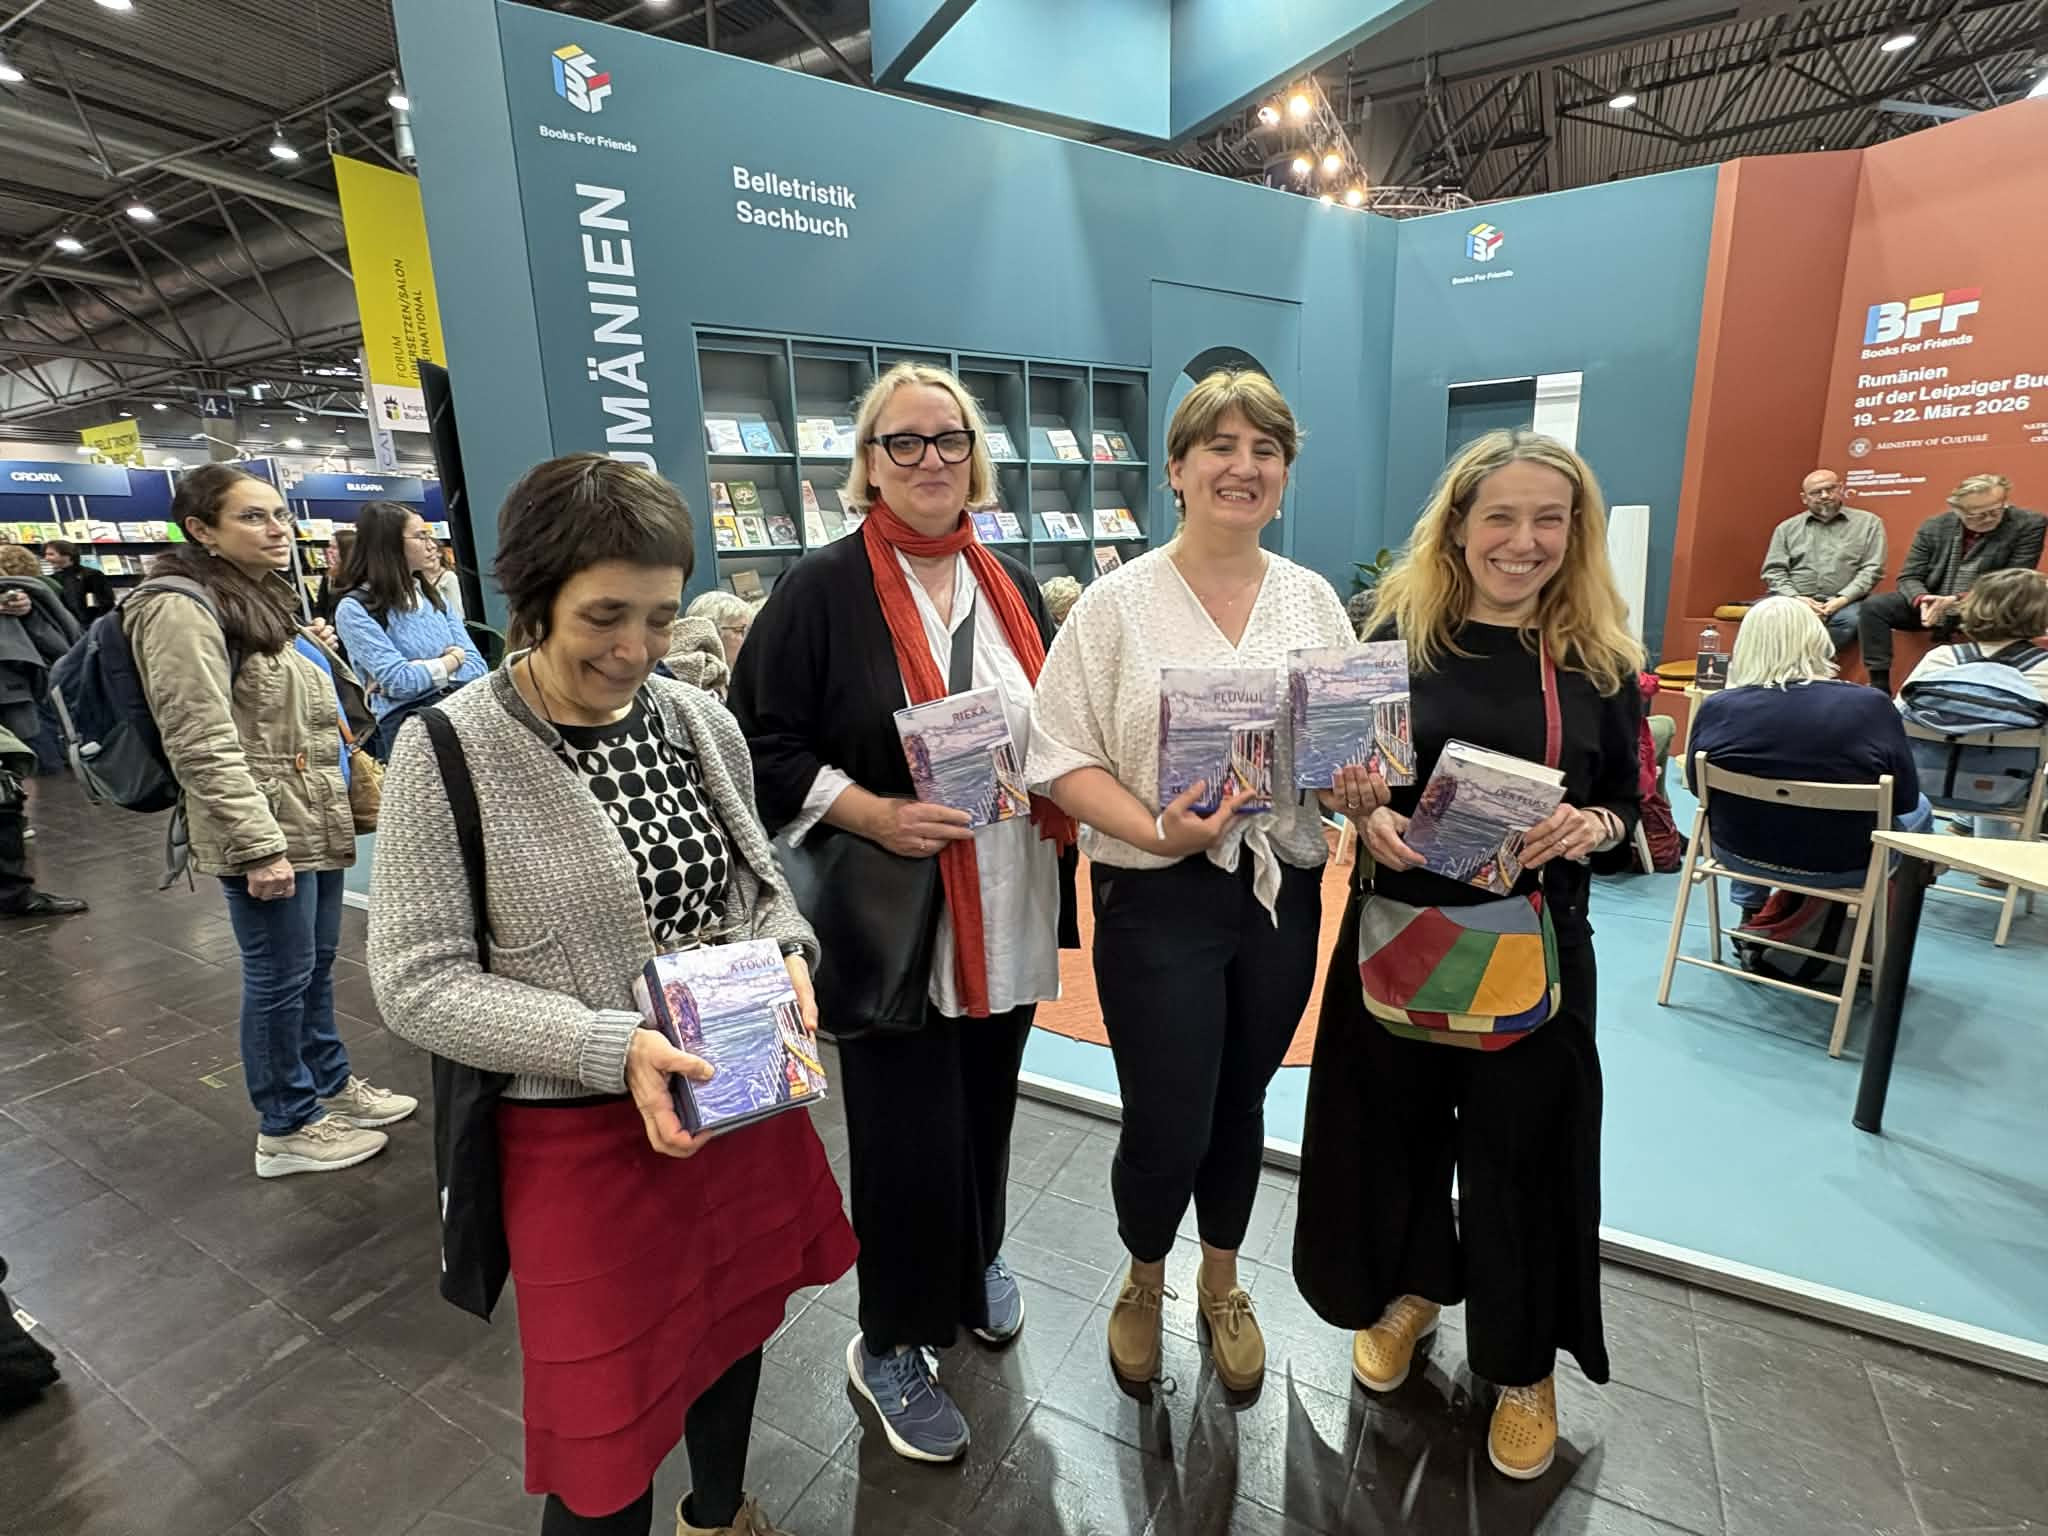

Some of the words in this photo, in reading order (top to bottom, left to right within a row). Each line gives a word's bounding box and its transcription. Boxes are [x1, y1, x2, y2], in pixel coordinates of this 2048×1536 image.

[539, 125, 576, 142] Books
[577, 132, 596, 145] For
[597, 136, 637, 153] Friends
[733, 165, 857, 210] Belletristik
[736, 200, 848, 239] Sachbuch
[415, 289, 432, 361] ERNATIONAL
[575, 183, 658, 474] UMÄNIEN
[392, 335, 406, 378] FORUM
[1861, 346, 1900, 359] Books
[1901, 342, 1923, 354] For
[1924, 334, 1974, 350] Friends
[1857, 366, 1948, 388] Rumänien
[1854, 391, 1883, 408] auf
[1885, 390, 1917, 404] der
[1918, 379, 2011, 401] Leipziger
[1852, 413, 1876, 427] 19.
[1892, 408, 1920, 424] 22.
[1923, 403, 1972, 420] März
[1974, 395, 2031, 415] 2026
[1875, 438, 1923, 450] MINISTRY
[1925, 437, 1939, 446] OF
[1941, 433, 1989, 445] CULTURE
[10, 471, 63, 482] CROATIA
[346, 483, 384, 492] BULGARIA
